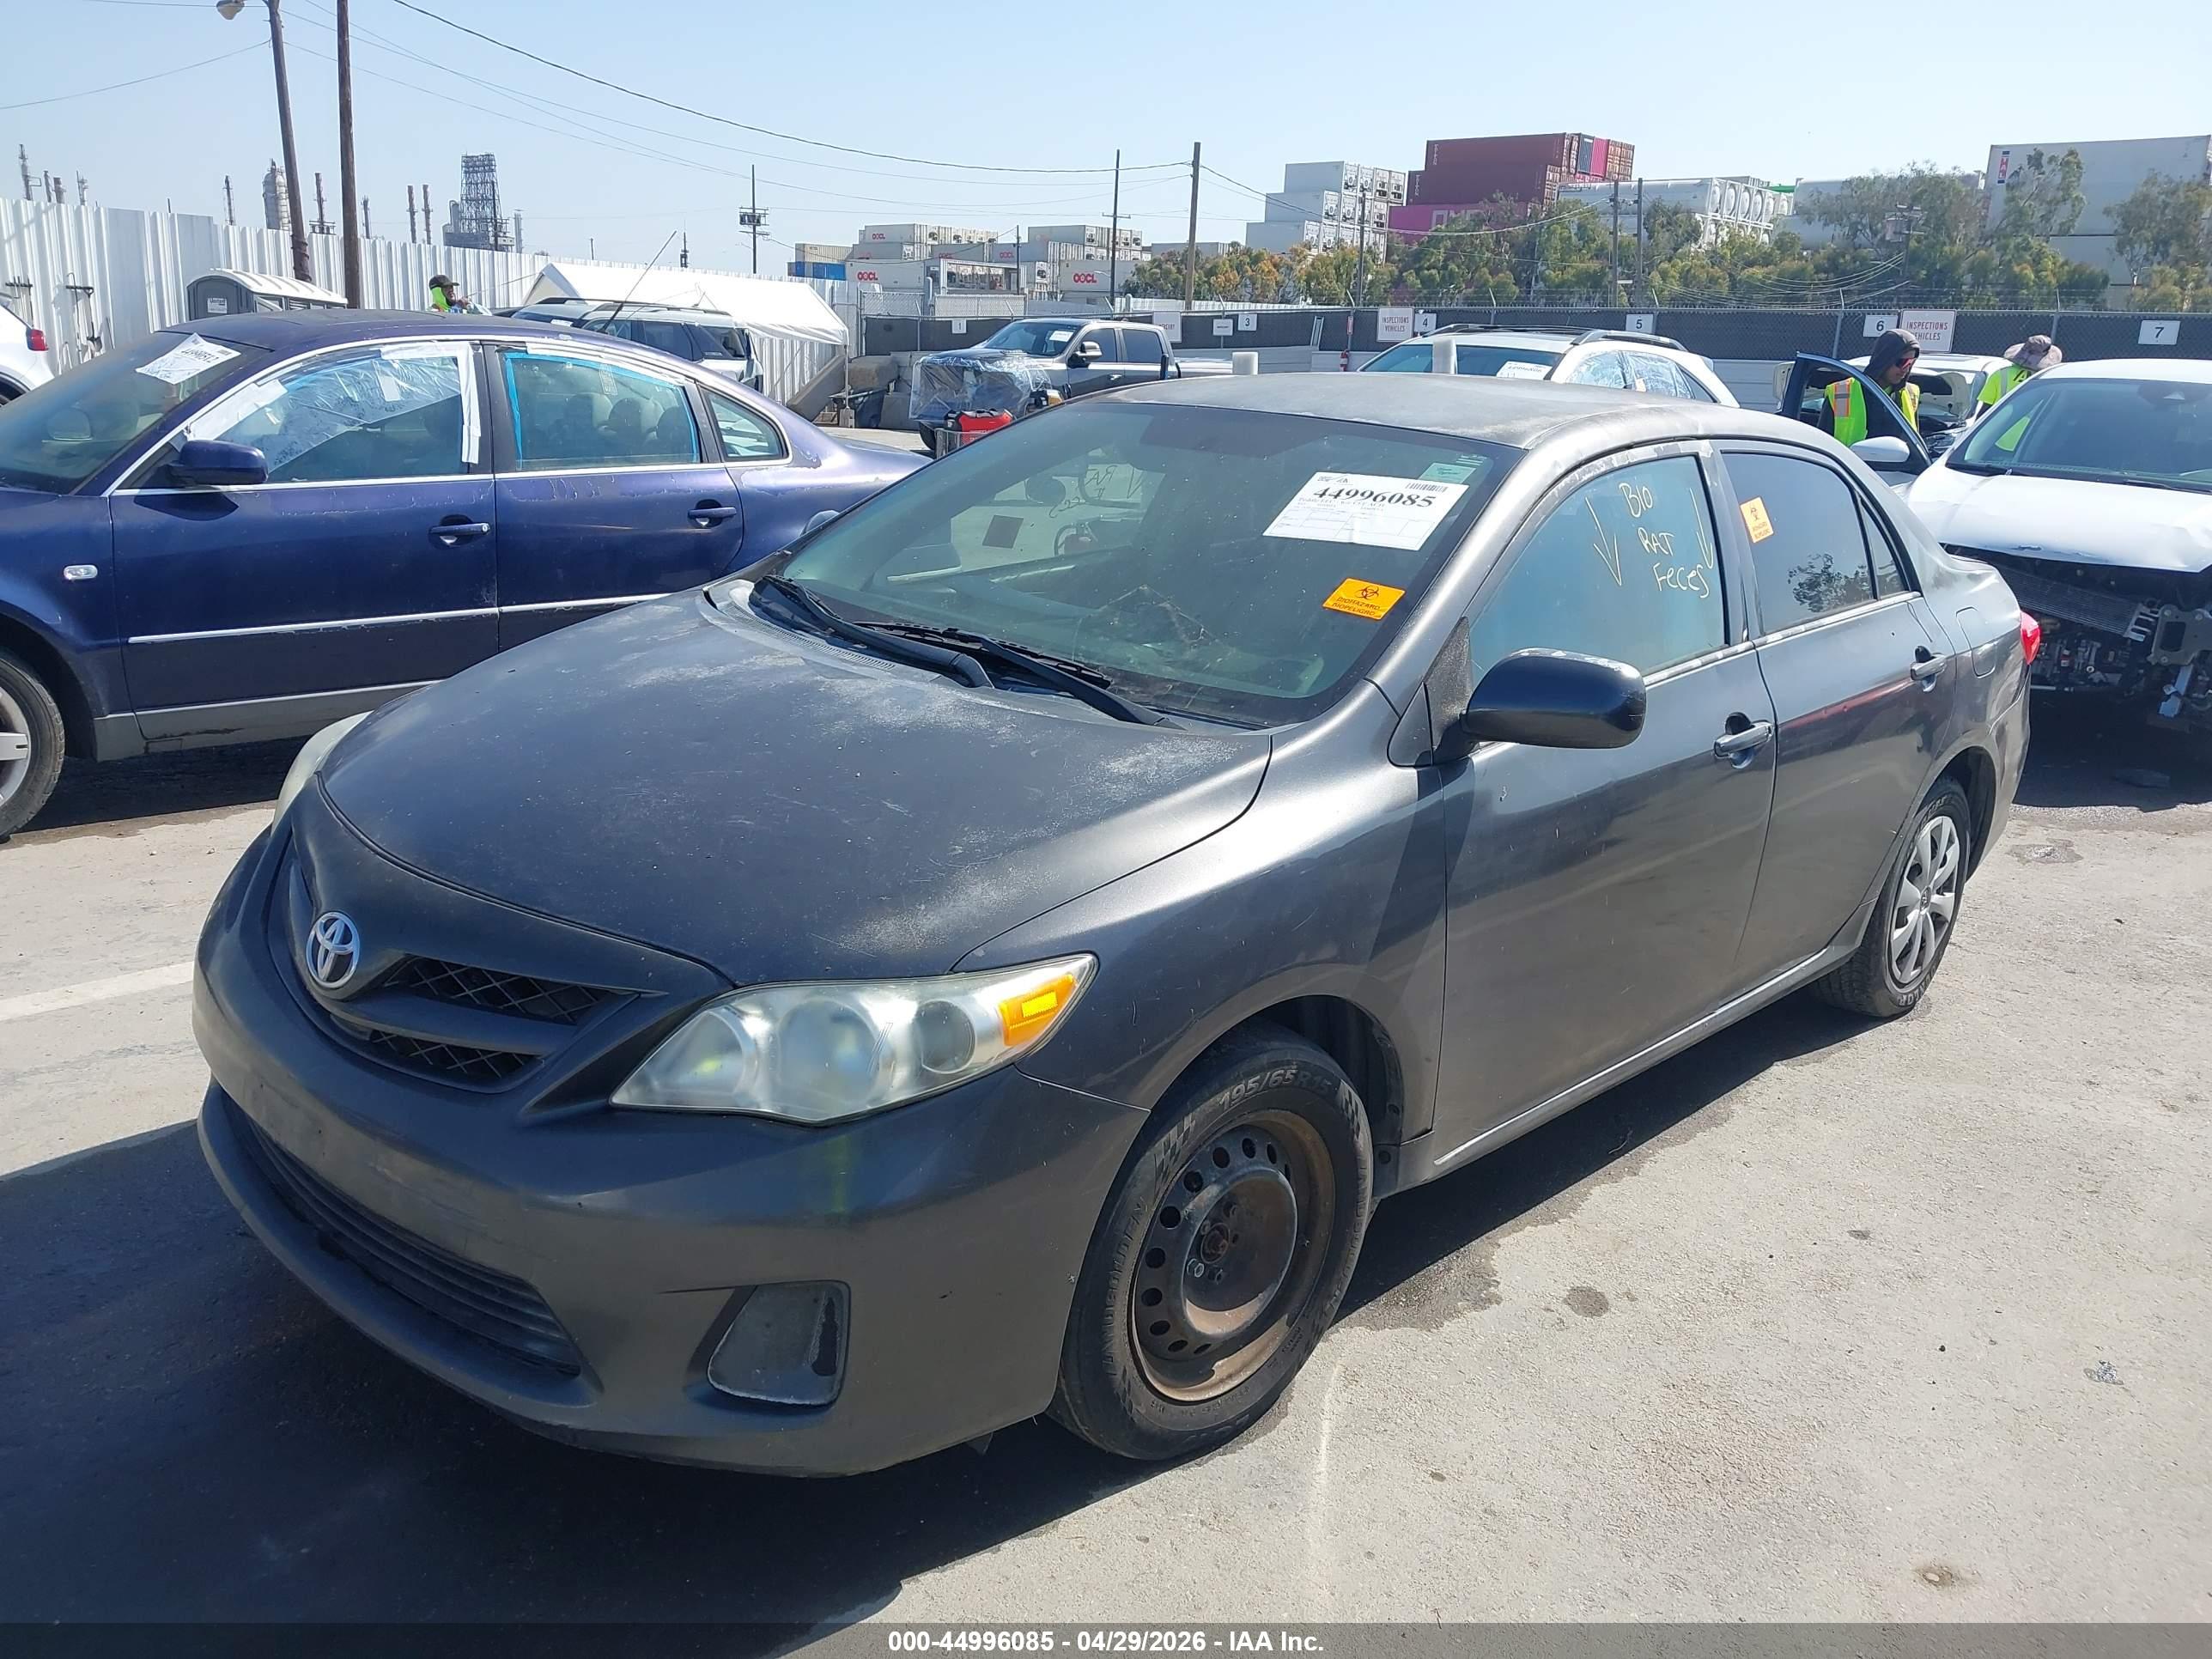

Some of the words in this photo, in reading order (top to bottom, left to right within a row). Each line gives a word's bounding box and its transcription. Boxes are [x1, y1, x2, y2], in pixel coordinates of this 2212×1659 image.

[857, 271, 878, 281] OOCL
[1073, 273, 1097, 283] OOCL
[1245, 318, 1250, 327] 3
[1382, 316, 1409, 325] INSPECTIONS
[1422, 317, 1429, 328] 4
[1636, 319, 1643, 330] 5
[1876, 320, 1885, 332] 6
[1906, 320, 1948, 331] INSPECTIONS
[1913, 331, 1942, 342] EHICLES
[2154, 326, 2165, 338] 7
[1312, 486, 1437, 508] 44996085
[1638, 526, 1675, 557] RAT
[1332, 602, 1376, 616] BIOPELIGRO
[1336, 597, 1381, 611] BIOHAZARD
